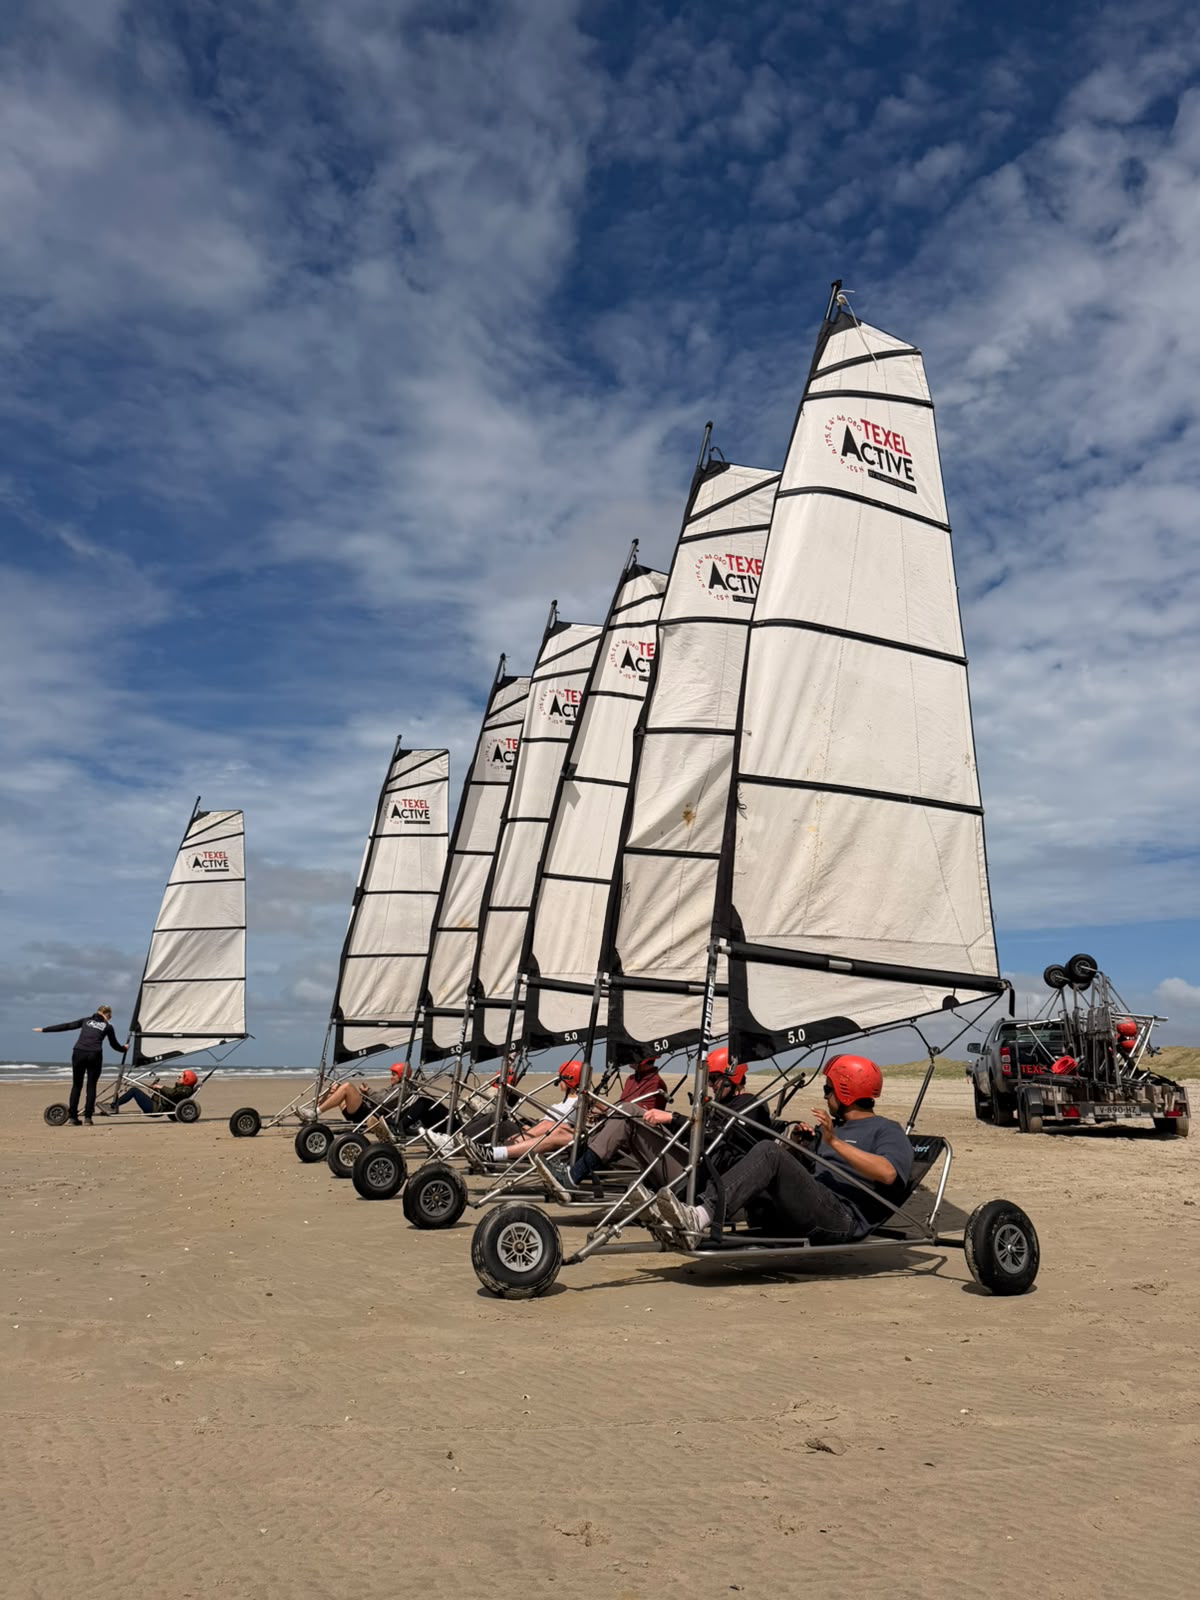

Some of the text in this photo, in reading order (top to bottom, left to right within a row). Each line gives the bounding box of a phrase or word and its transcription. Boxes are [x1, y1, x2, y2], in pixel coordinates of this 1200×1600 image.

[860, 418, 912, 457] TEXEL
[841, 424, 915, 482] ACTIVE
[725, 553, 763, 576] TEXE
[402, 799, 430, 809] TEXEL
[391, 803, 430, 820] ACTIVE
[203, 851, 228, 859] TEXEL
[192, 856, 229, 869] ACTIVE
[564, 1031, 578, 1042] 5.0
[787, 1028, 806, 1044] 5.0
[654, 1039, 670, 1052] 5.0
